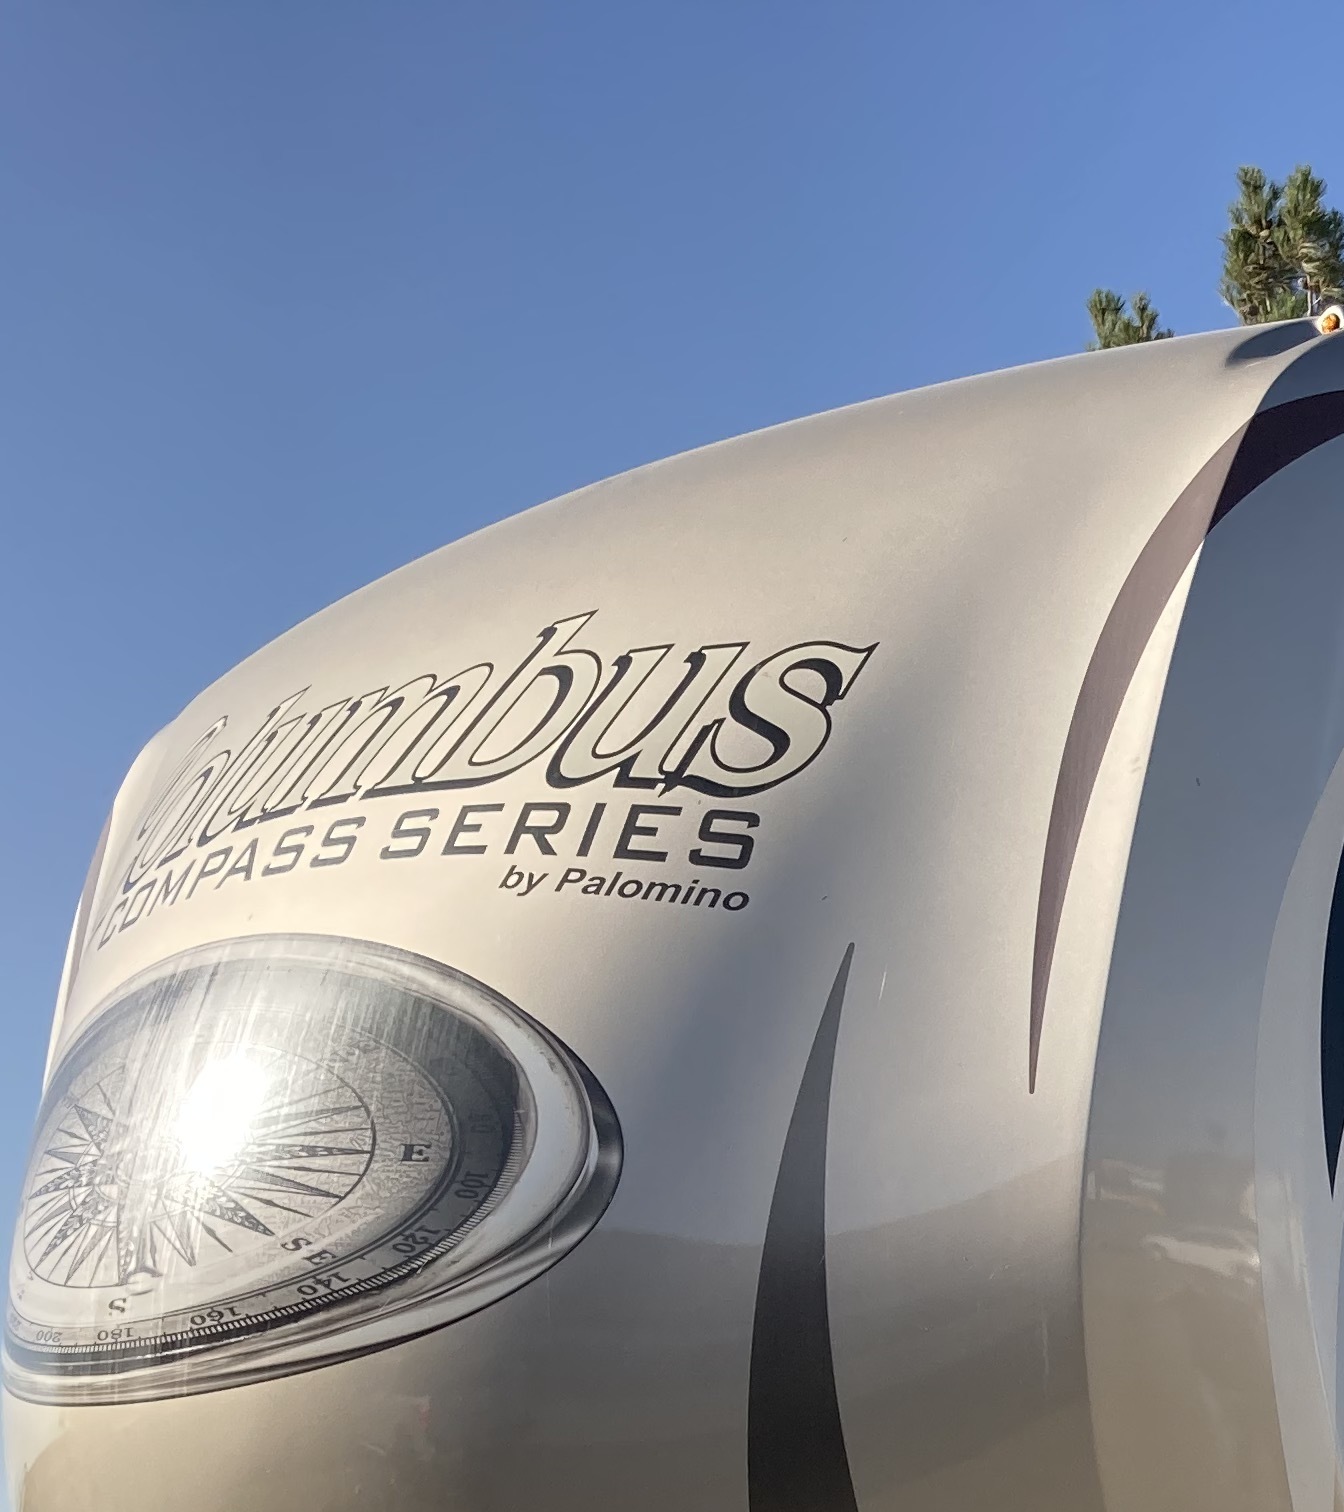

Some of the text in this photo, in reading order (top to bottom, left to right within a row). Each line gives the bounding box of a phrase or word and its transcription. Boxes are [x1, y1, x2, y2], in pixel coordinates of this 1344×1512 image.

[123, 609, 881, 896] Columbus
[97, 802, 761, 950] COMPASS SERIES
[498, 864, 750, 912] by Palomino
[400, 1143, 432, 1162] E
[454, 1171, 490, 1199] 100
[392, 1224, 441, 1254] 120
[296, 1271, 352, 1296] 140
[108, 1297, 127, 1317] S
[190, 1305, 242, 1326] 160
[97, 1327, 135, 1341] 180
